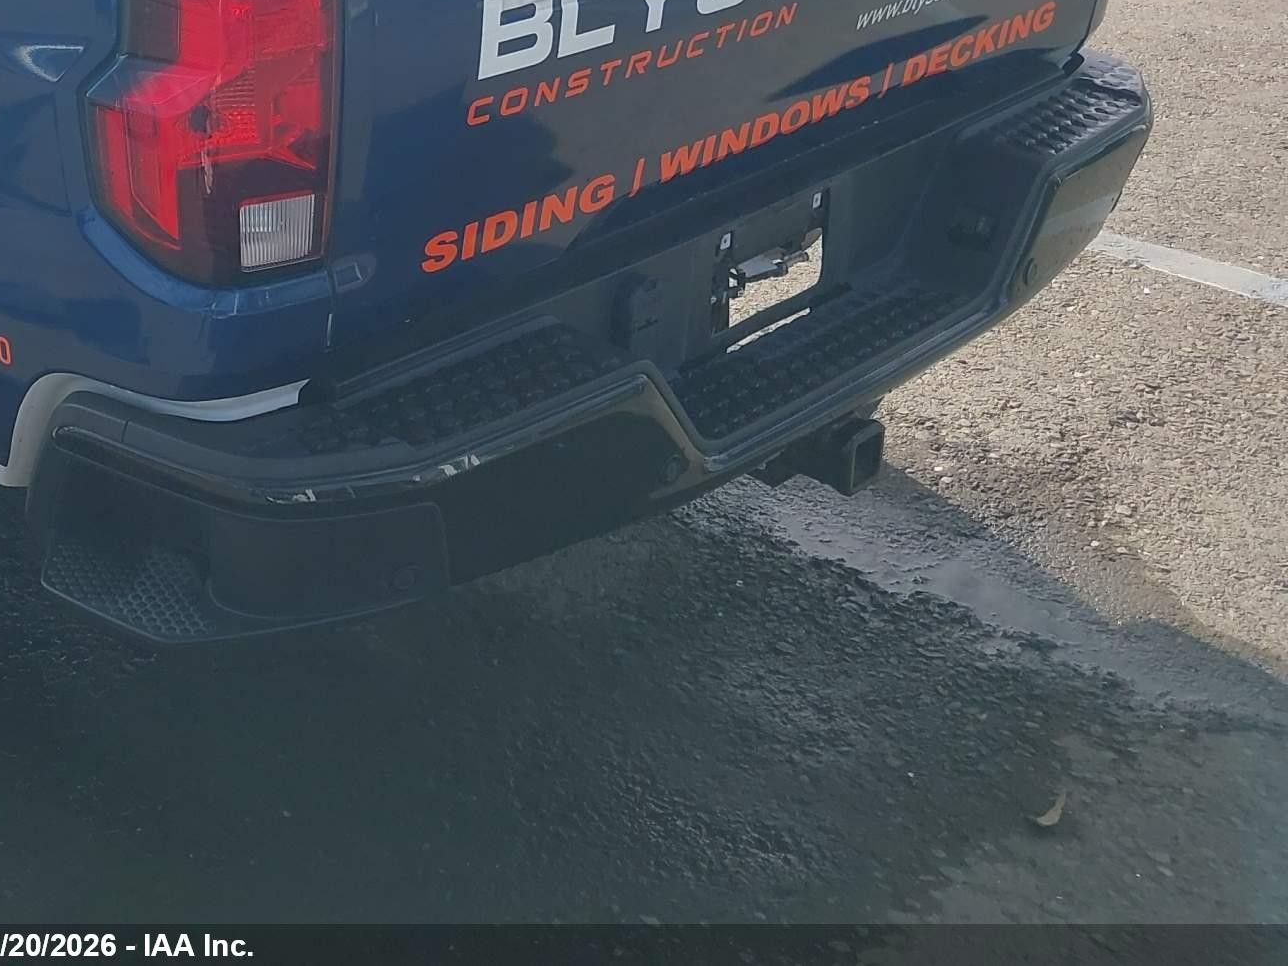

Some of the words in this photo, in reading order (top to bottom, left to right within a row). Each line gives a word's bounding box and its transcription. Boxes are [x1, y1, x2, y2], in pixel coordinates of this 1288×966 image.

[420, 173, 616, 273] SIDING
[659, 75, 871, 184] WINDOWS
[899, 1, 1057, 88] DECKING
[466, 2, 798, 126] CONSTRUCTION
